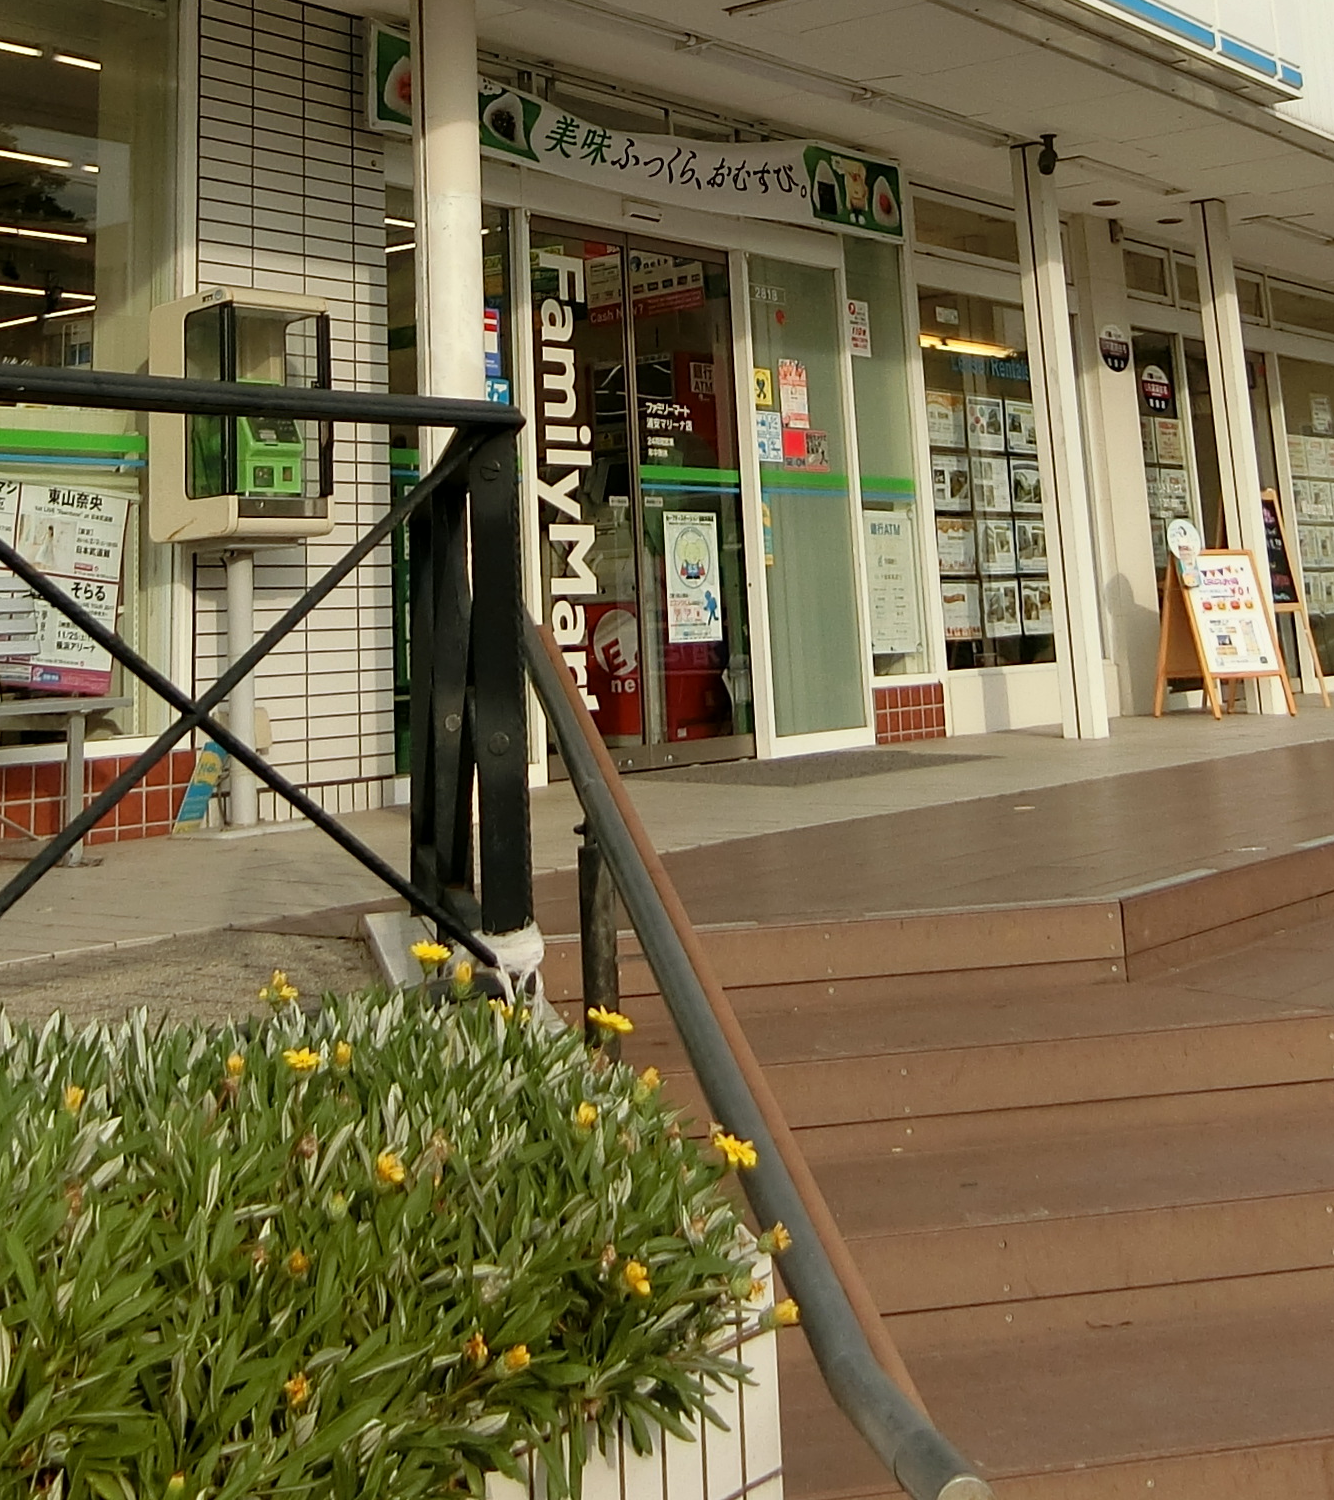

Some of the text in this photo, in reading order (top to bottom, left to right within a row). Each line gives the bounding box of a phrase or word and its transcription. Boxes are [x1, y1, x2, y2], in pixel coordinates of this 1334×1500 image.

[544, 116, 807, 199] 美味ふっくら、おむすび。
[645, 402, 691, 418] ファミリーマート
[48, 488, 103, 511] 東山奈央
[71, 582, 106, 601] そらる
[610, 678, 636, 693] ne
